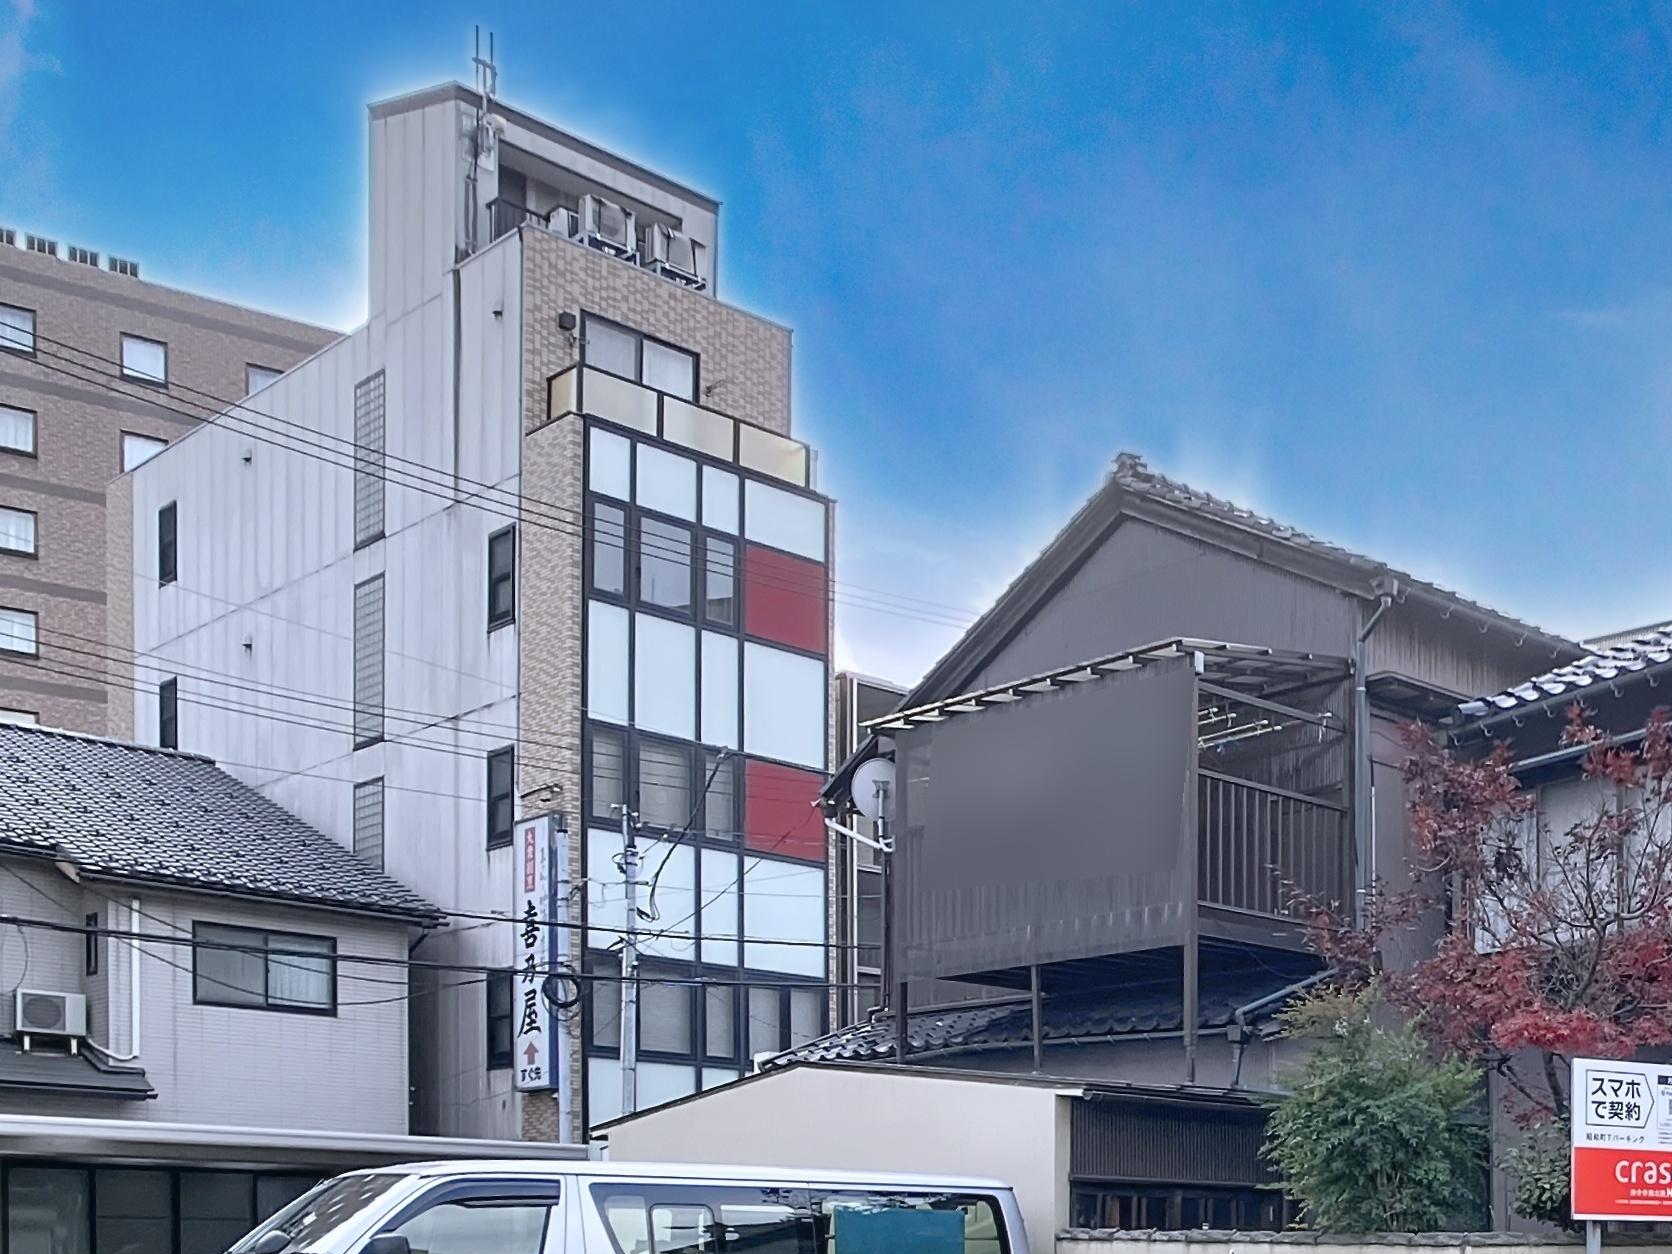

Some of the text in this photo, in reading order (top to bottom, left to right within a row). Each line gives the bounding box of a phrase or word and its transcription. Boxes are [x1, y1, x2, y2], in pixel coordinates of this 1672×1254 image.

[1591, 1077, 1641, 1099] スマホ
[1591, 1100, 1641, 1121] で契約
